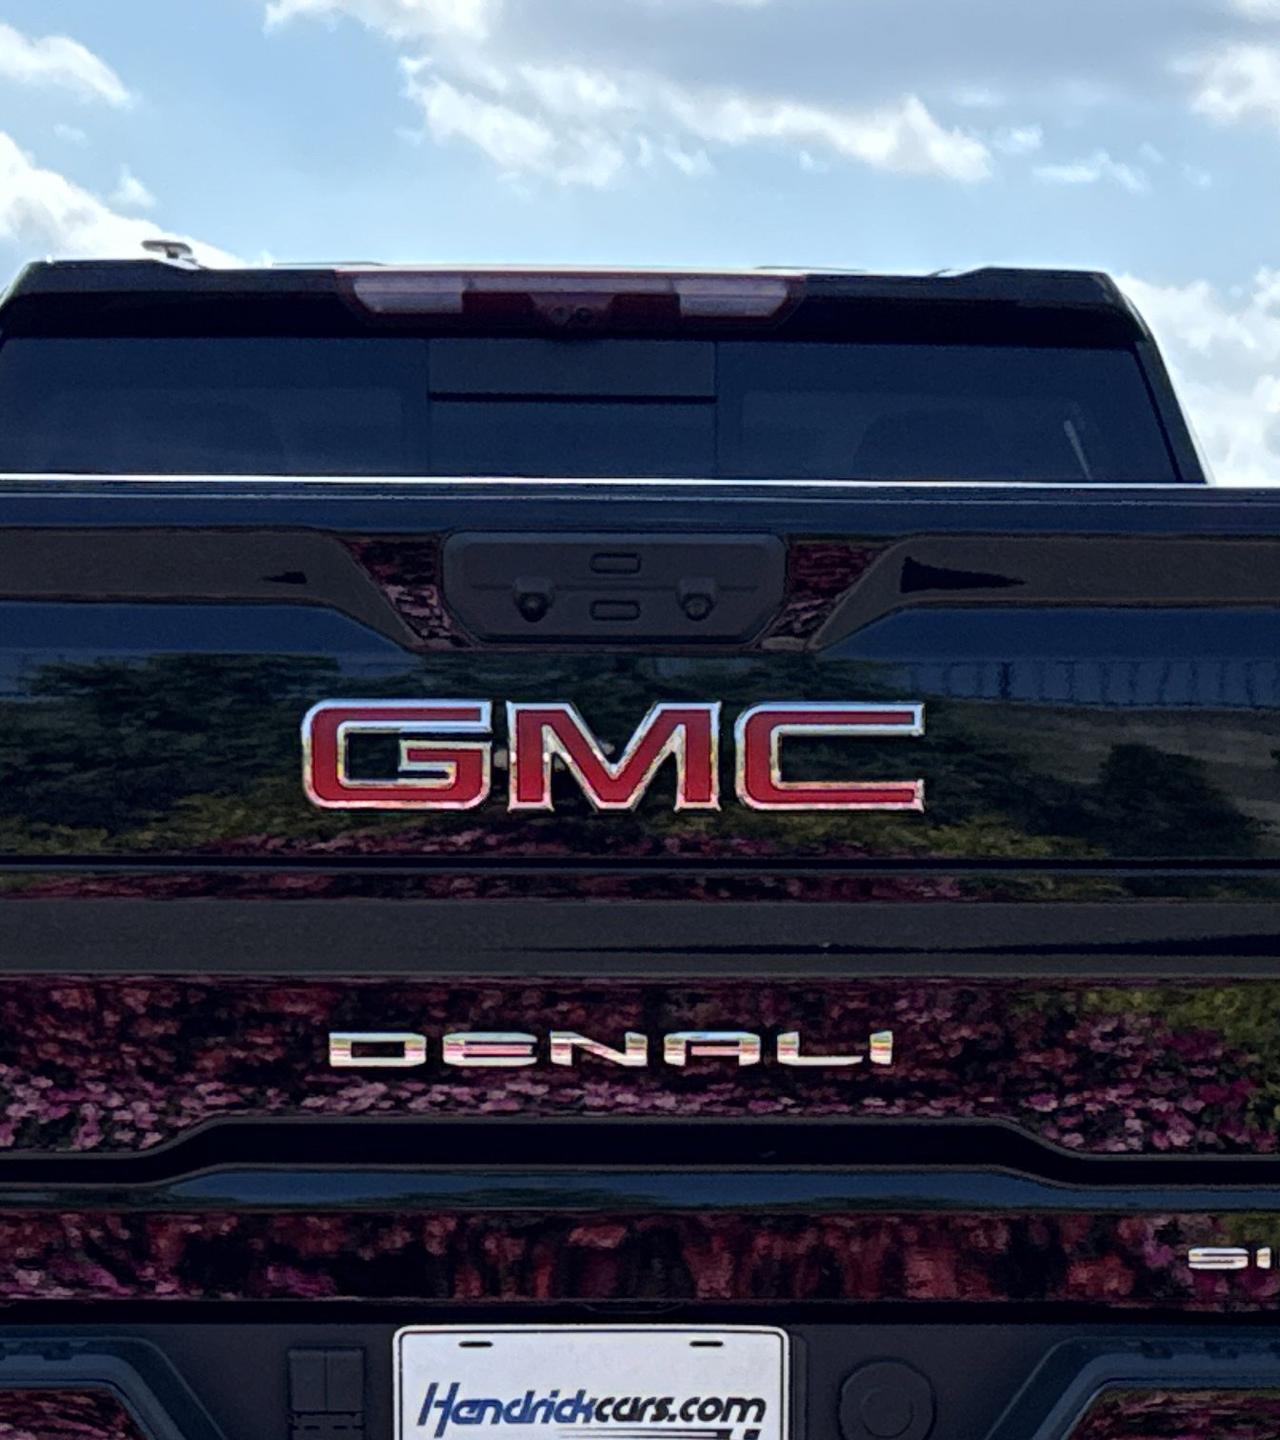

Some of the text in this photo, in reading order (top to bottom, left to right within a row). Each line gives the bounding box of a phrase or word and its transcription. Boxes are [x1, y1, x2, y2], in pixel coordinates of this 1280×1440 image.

[301, 699, 926, 812] GMC
[328, 1031, 894, 1068] DENALI
[417, 1381, 766, 1438] Hendrickcars.com
